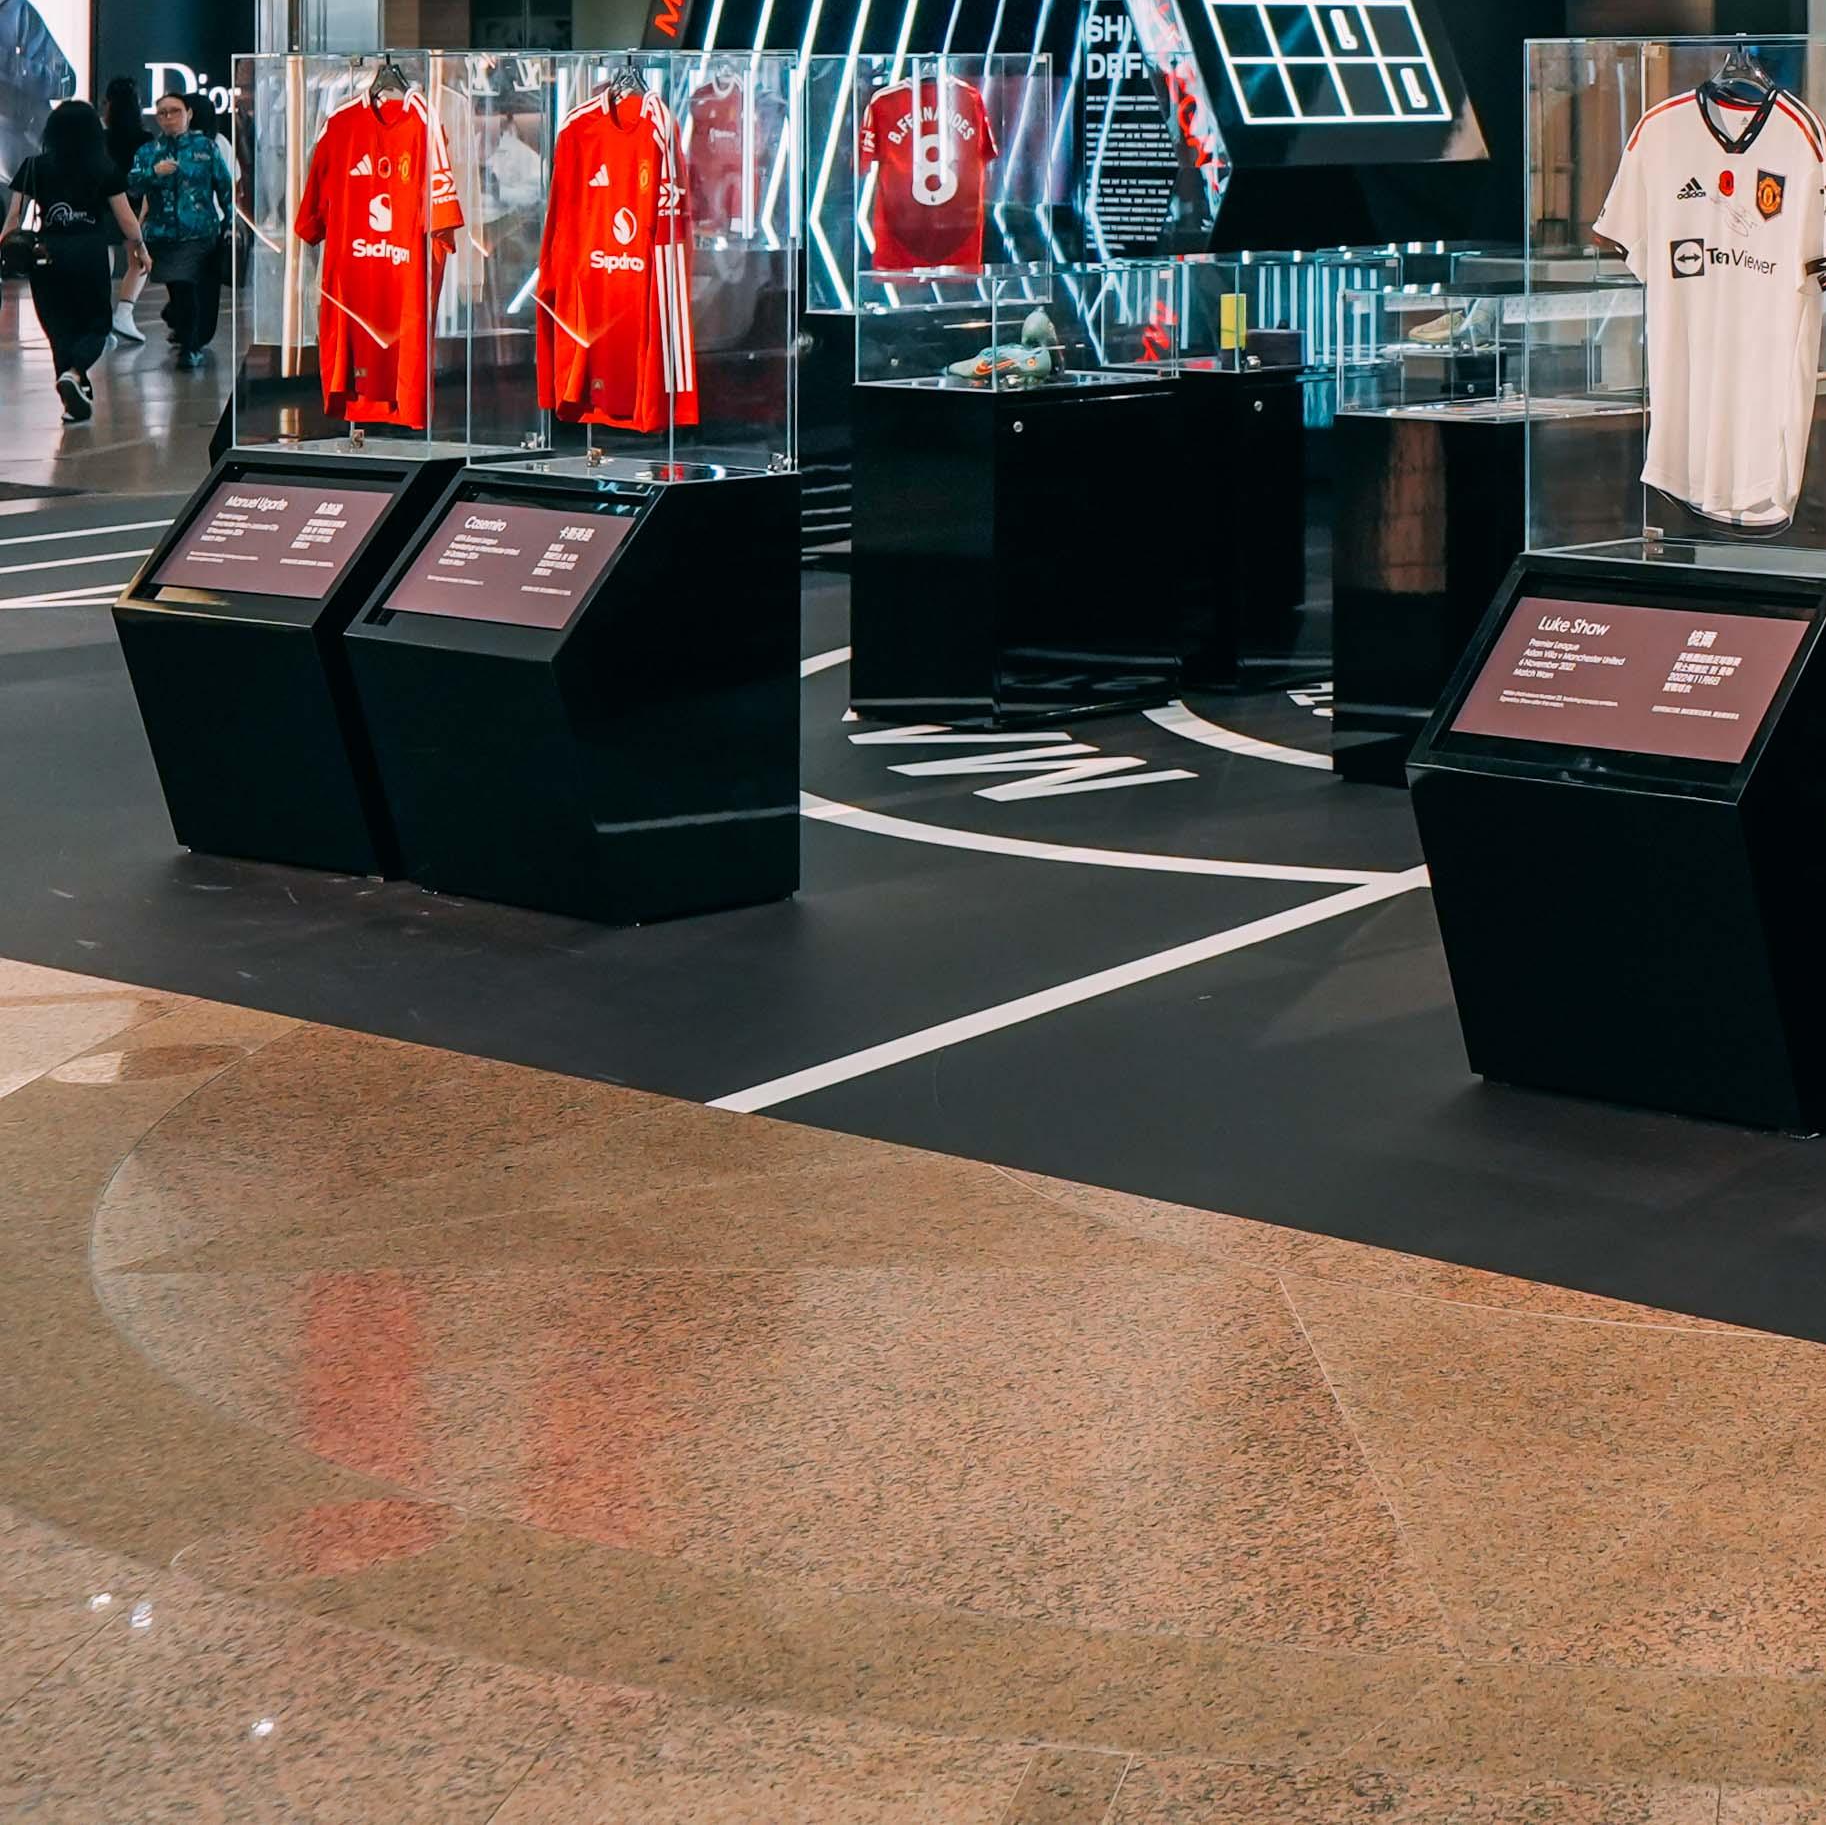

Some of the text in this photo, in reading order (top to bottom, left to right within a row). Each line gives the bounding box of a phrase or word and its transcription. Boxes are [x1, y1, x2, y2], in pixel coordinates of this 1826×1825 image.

[1676, 189, 1706, 201] adidas
[1538, 615, 1611, 637] Luke Shaw
[1554, 640, 1580, 652] League
[1525, 659, 1559, 670] November
